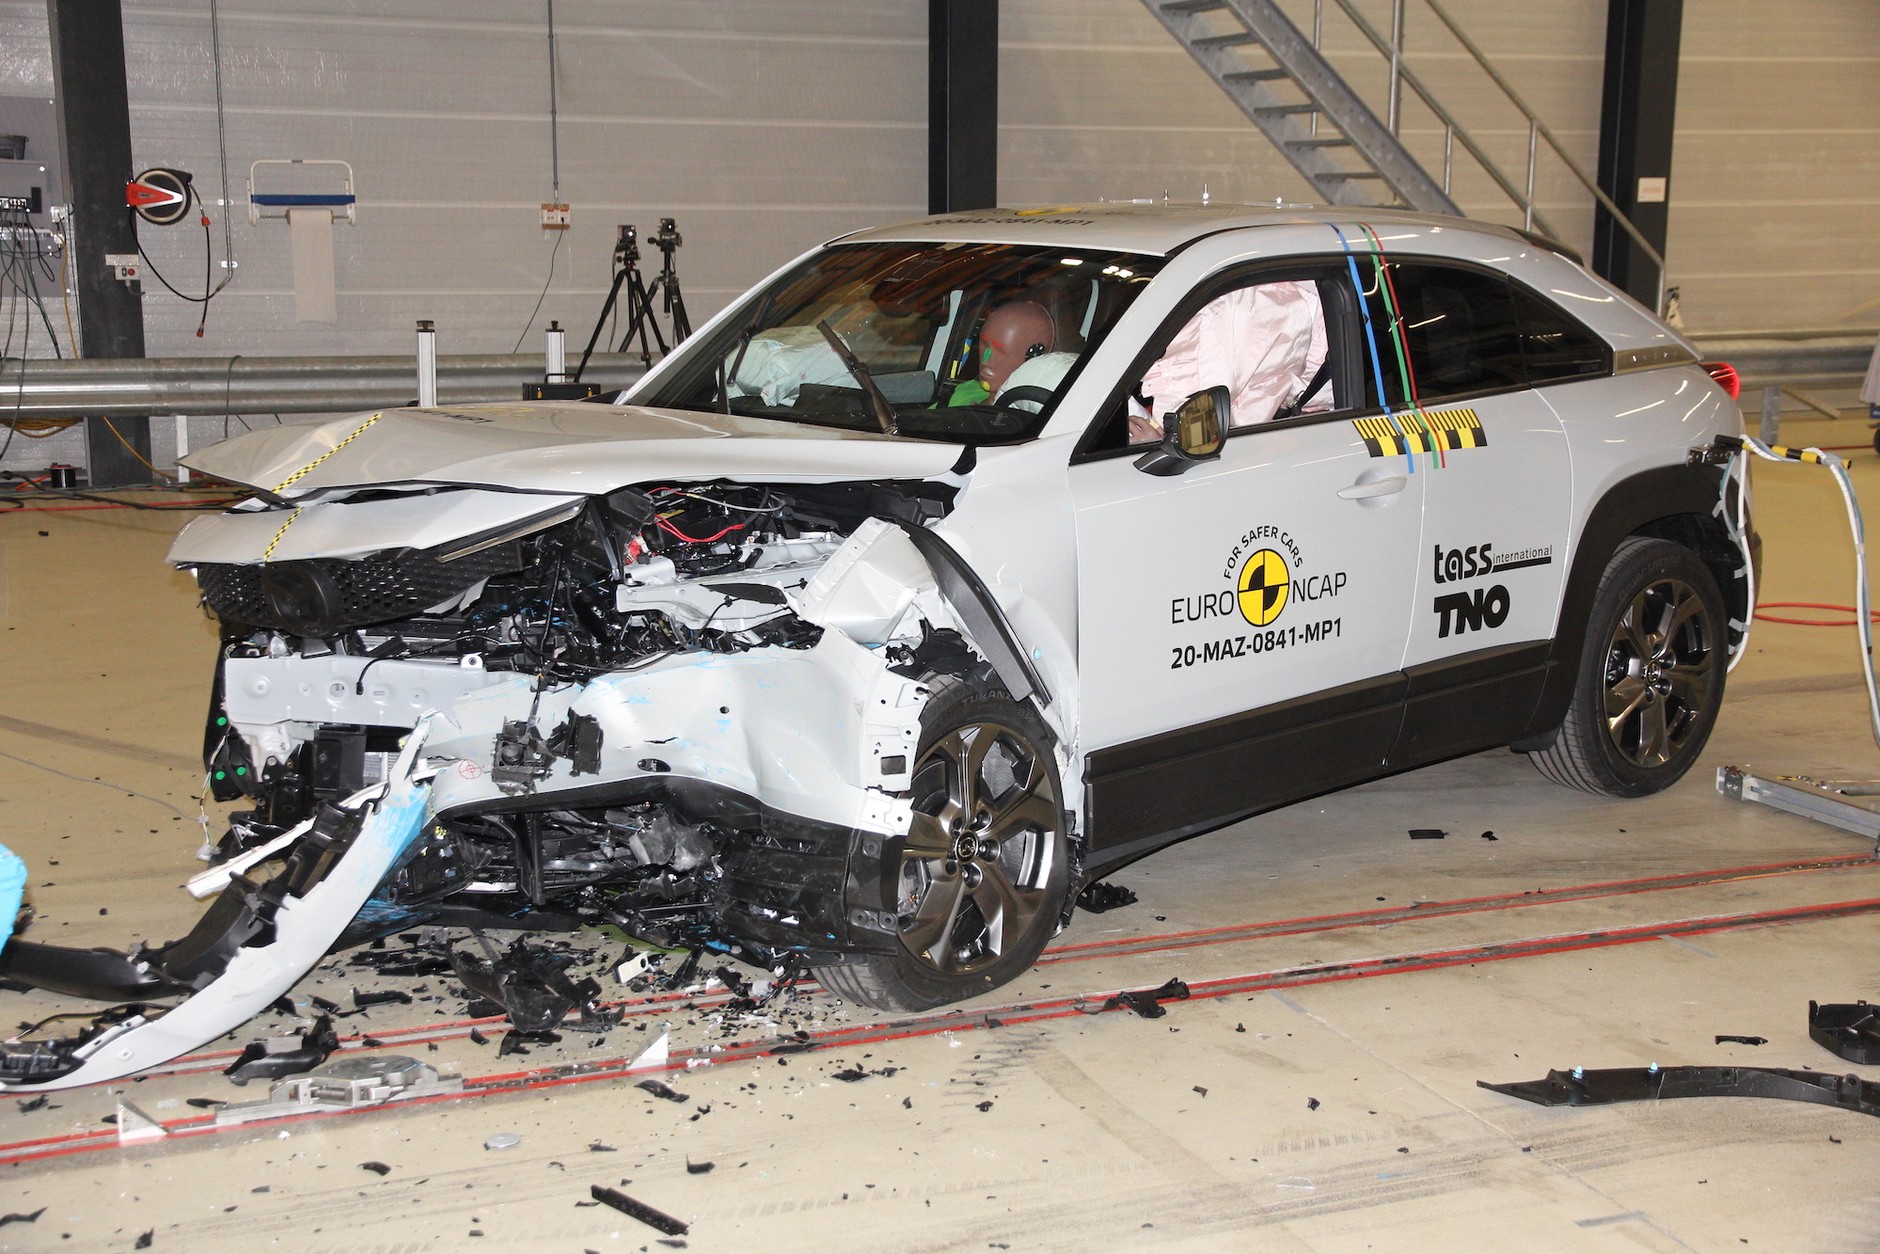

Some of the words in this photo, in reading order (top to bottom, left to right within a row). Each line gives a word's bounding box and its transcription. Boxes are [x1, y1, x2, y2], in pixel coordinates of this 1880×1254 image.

[1224, 546, 1242, 579] FOR
[1241, 525, 1279, 548] SAFER
[1280, 532, 1303, 568] CARS
[1493, 544, 1552, 565] international
[1172, 590, 1235, 624] EURO
[1292, 572, 1347, 604] NCAP
[1434, 584, 1511, 638] TNO
[1171, 617, 1341, 669] 20-MAZ-0841-MP1
[961, 689, 1014, 706] TURANZ
